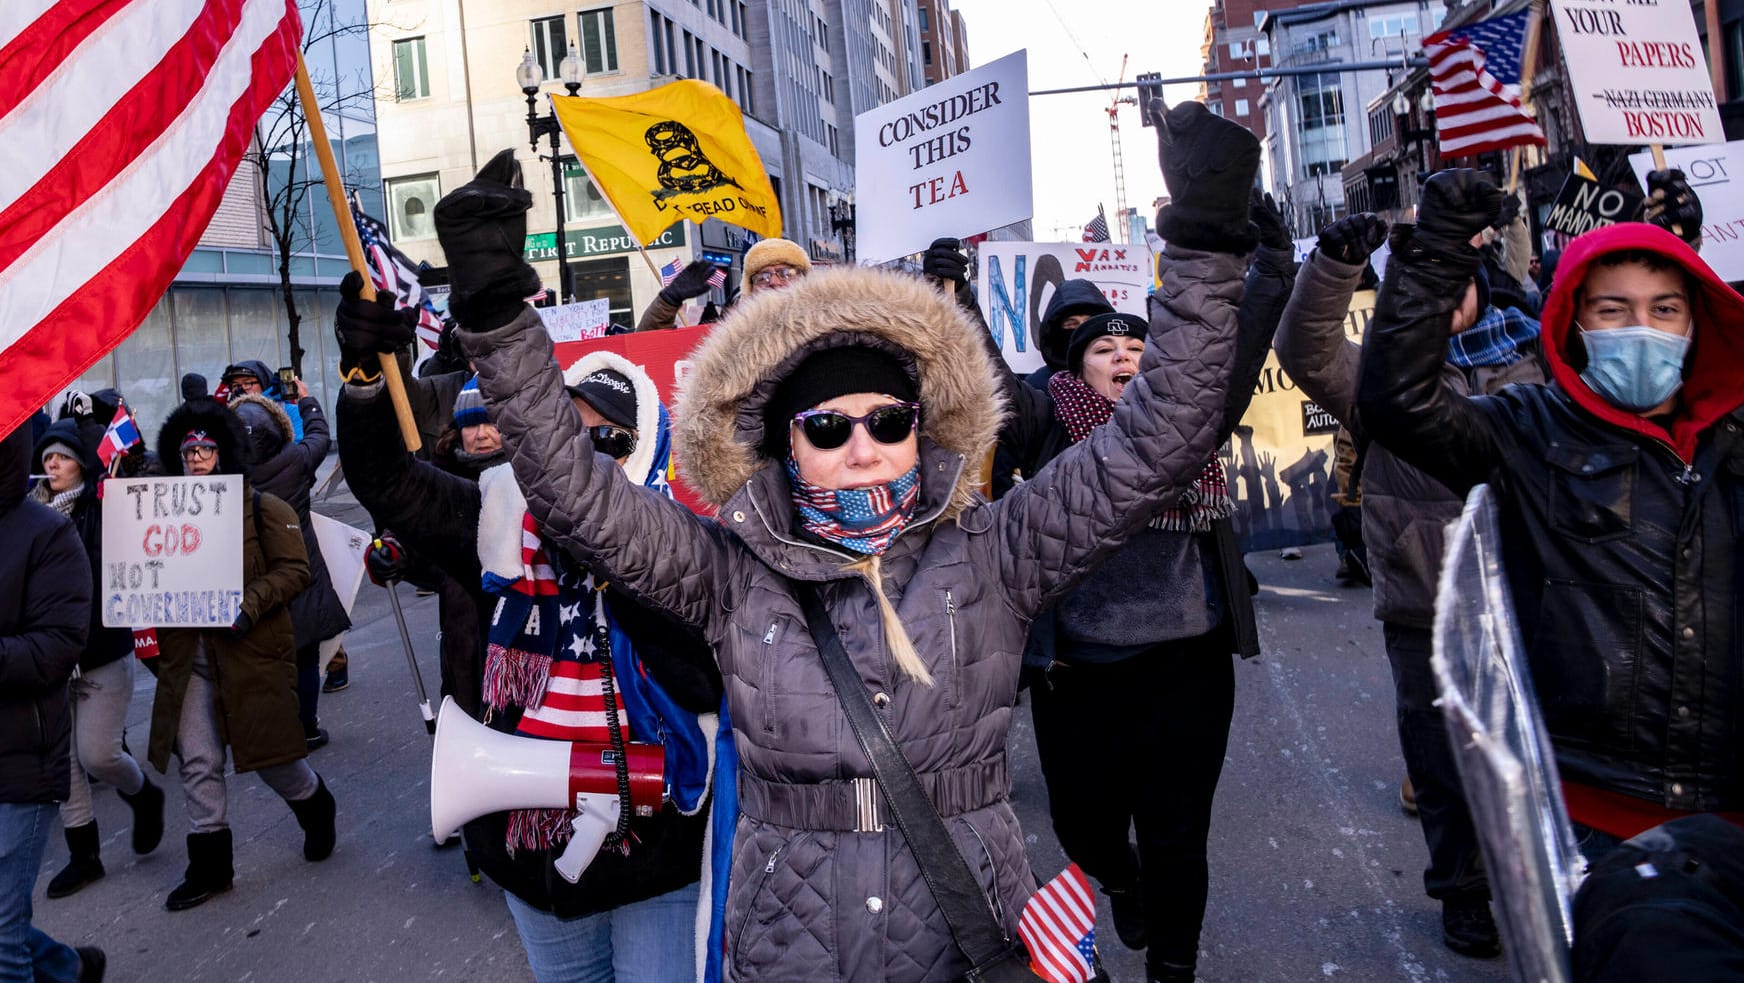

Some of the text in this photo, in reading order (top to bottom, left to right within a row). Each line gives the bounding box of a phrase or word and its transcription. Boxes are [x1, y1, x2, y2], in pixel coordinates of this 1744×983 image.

[1565, 7, 1627, 36] YOUR
[1616, 40, 1696, 69] PAPERS
[1643, 88, 1715, 110] GERMANY
[878, 81, 1002, 148] CONSIDER
[1622, 110, 1705, 138] BOSTON
[908, 126, 972, 170] THIS
[1677, 156, 1729, 182] OT
[908, 170, 970, 210] TEA
[1573, 182, 1625, 217] NO
[684, 197, 736, 216] READ
[1545, 202, 1616, 238] MANDAT
[528, 239, 577, 260] FIRT
[582, 230, 673, 254] REPUIC
[1074, 247, 1128, 263] VAX
[987, 253, 1066, 353] NO
[580, 322, 609, 341] BOTH
[127, 482, 228, 520] TRUST
[143, 523, 200, 557] GOD
[109, 560, 164, 590] NOT
[106, 588, 242, 625] GOVERNMENT
